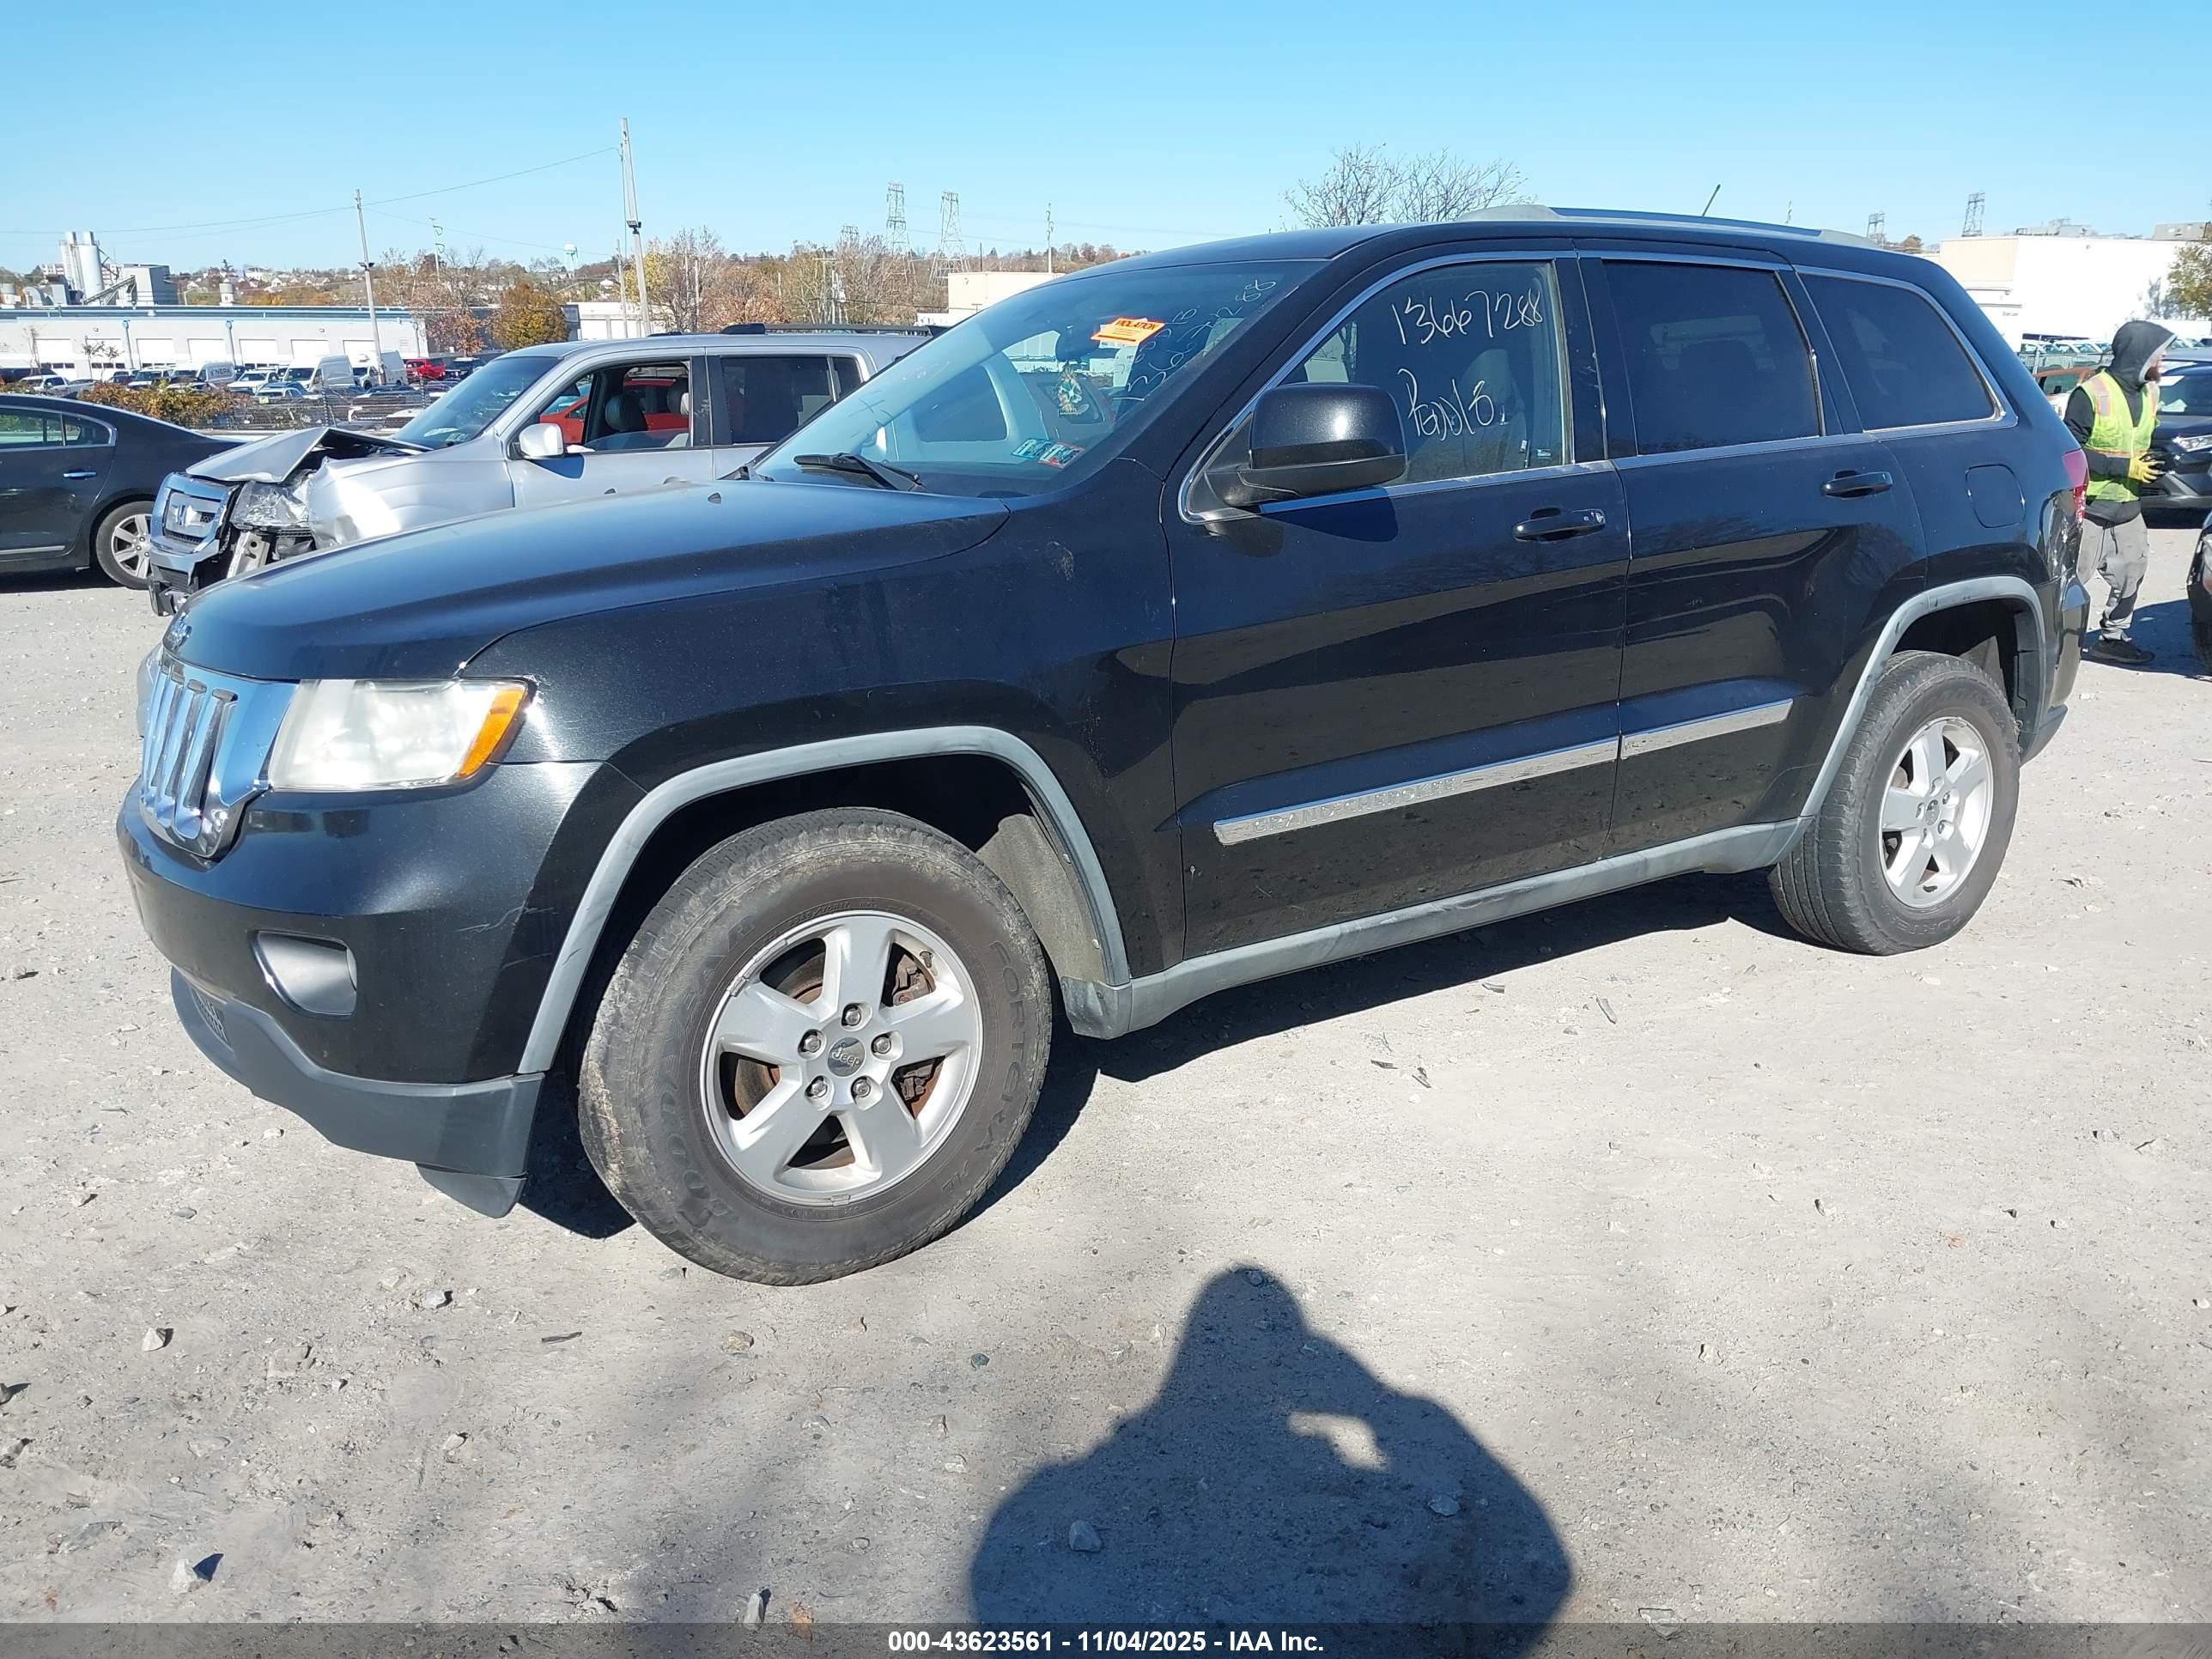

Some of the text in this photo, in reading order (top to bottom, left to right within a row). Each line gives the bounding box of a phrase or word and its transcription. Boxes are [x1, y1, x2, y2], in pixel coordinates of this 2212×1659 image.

[1391, 288, 1543, 345] 13667288
[1253, 777, 1458, 833] GRAND CHEROKEE
[831, 1046, 860, 1067] Jeep
